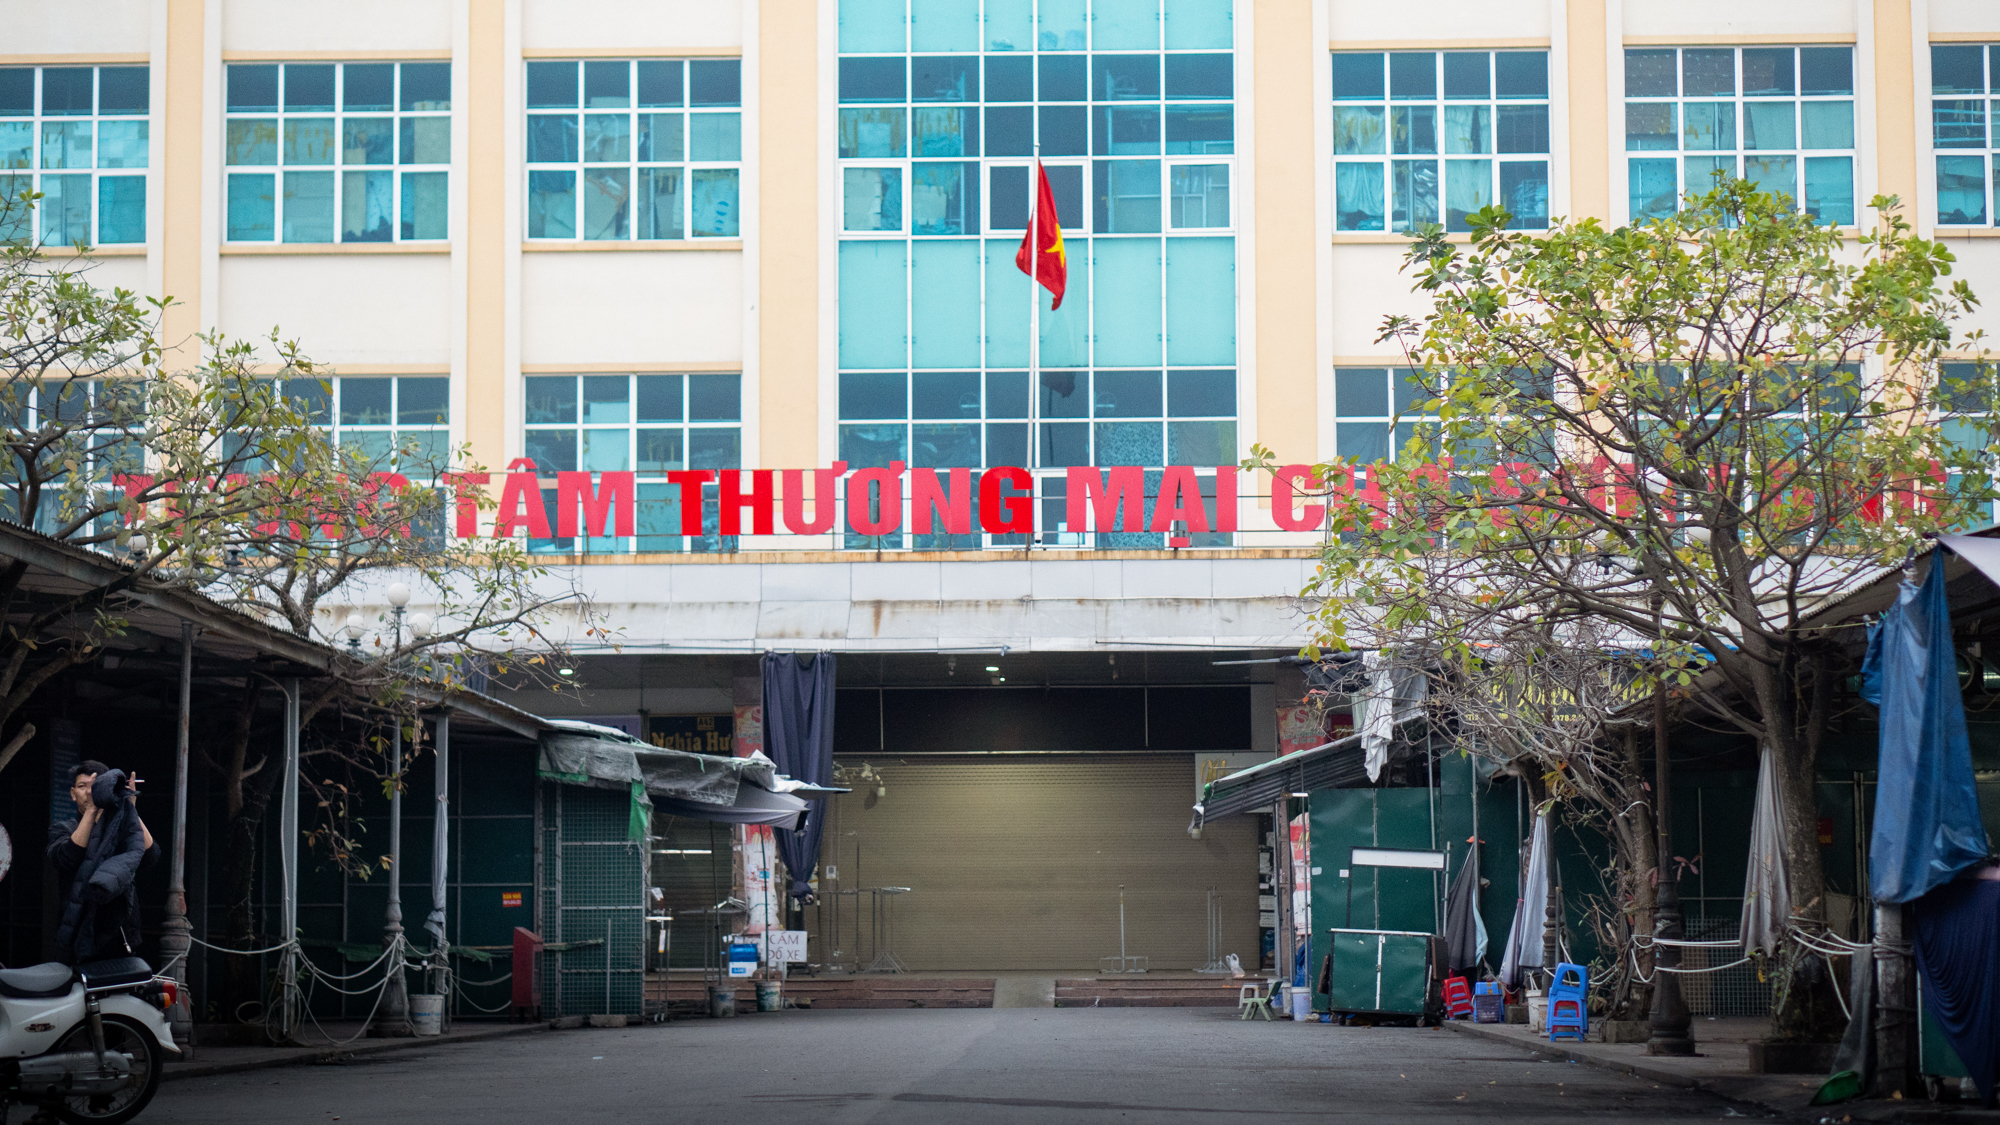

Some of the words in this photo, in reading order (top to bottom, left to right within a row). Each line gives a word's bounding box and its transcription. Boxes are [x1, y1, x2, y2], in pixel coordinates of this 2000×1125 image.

[443, 457, 634, 539] TÂM
[668, 460, 1033, 536] THƯƠNG
[1066, 465, 1238, 548] MẠI
[651, 731, 702, 751] Nghĩa
[706, 731, 733, 751] Hư
[786, 949, 801, 961] XE
